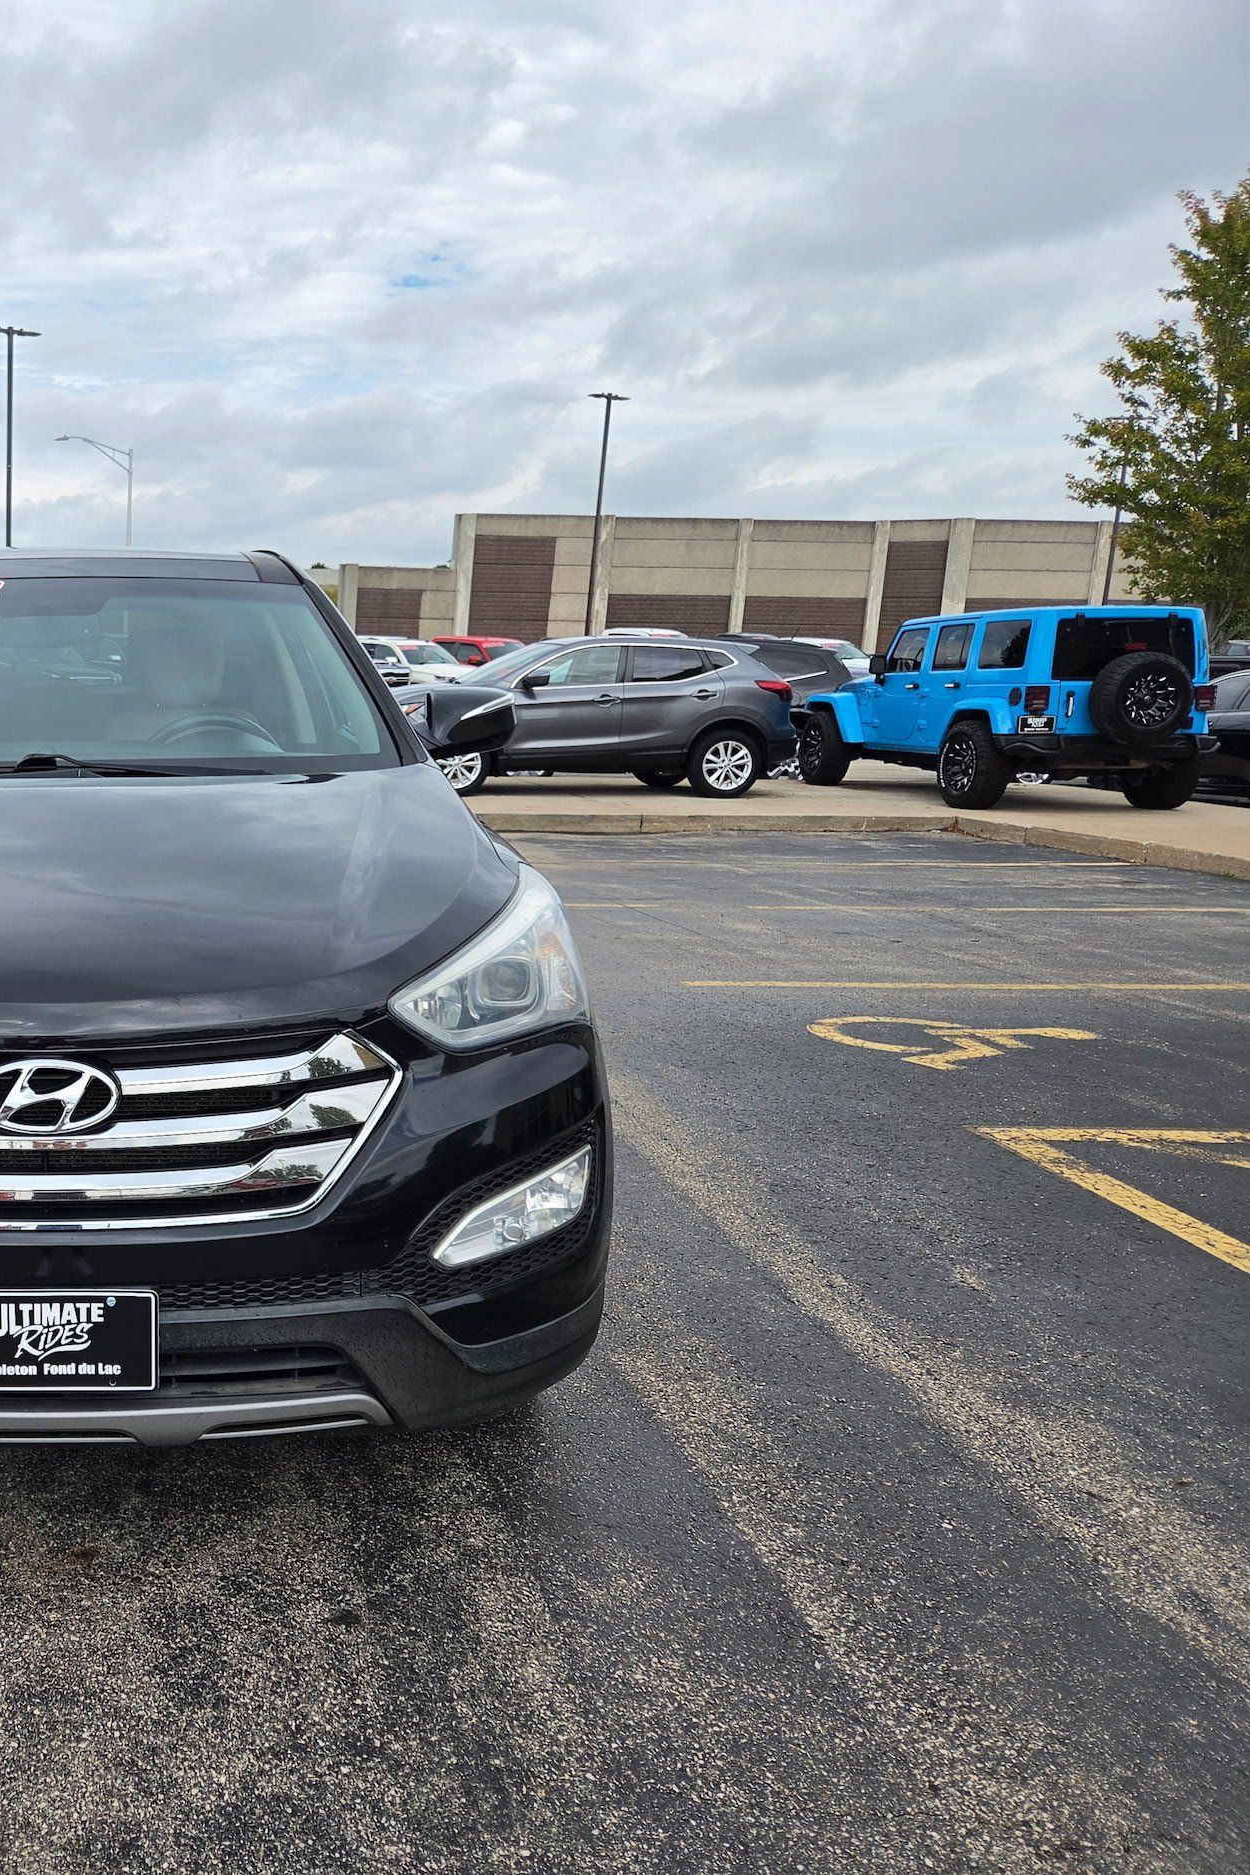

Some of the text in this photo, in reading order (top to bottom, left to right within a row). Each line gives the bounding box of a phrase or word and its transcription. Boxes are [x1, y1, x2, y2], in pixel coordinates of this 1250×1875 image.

[43, 1363, 76, 1375] Fond
[78, 1363, 96, 1375] du
[98, 1363, 121, 1375] Lac
